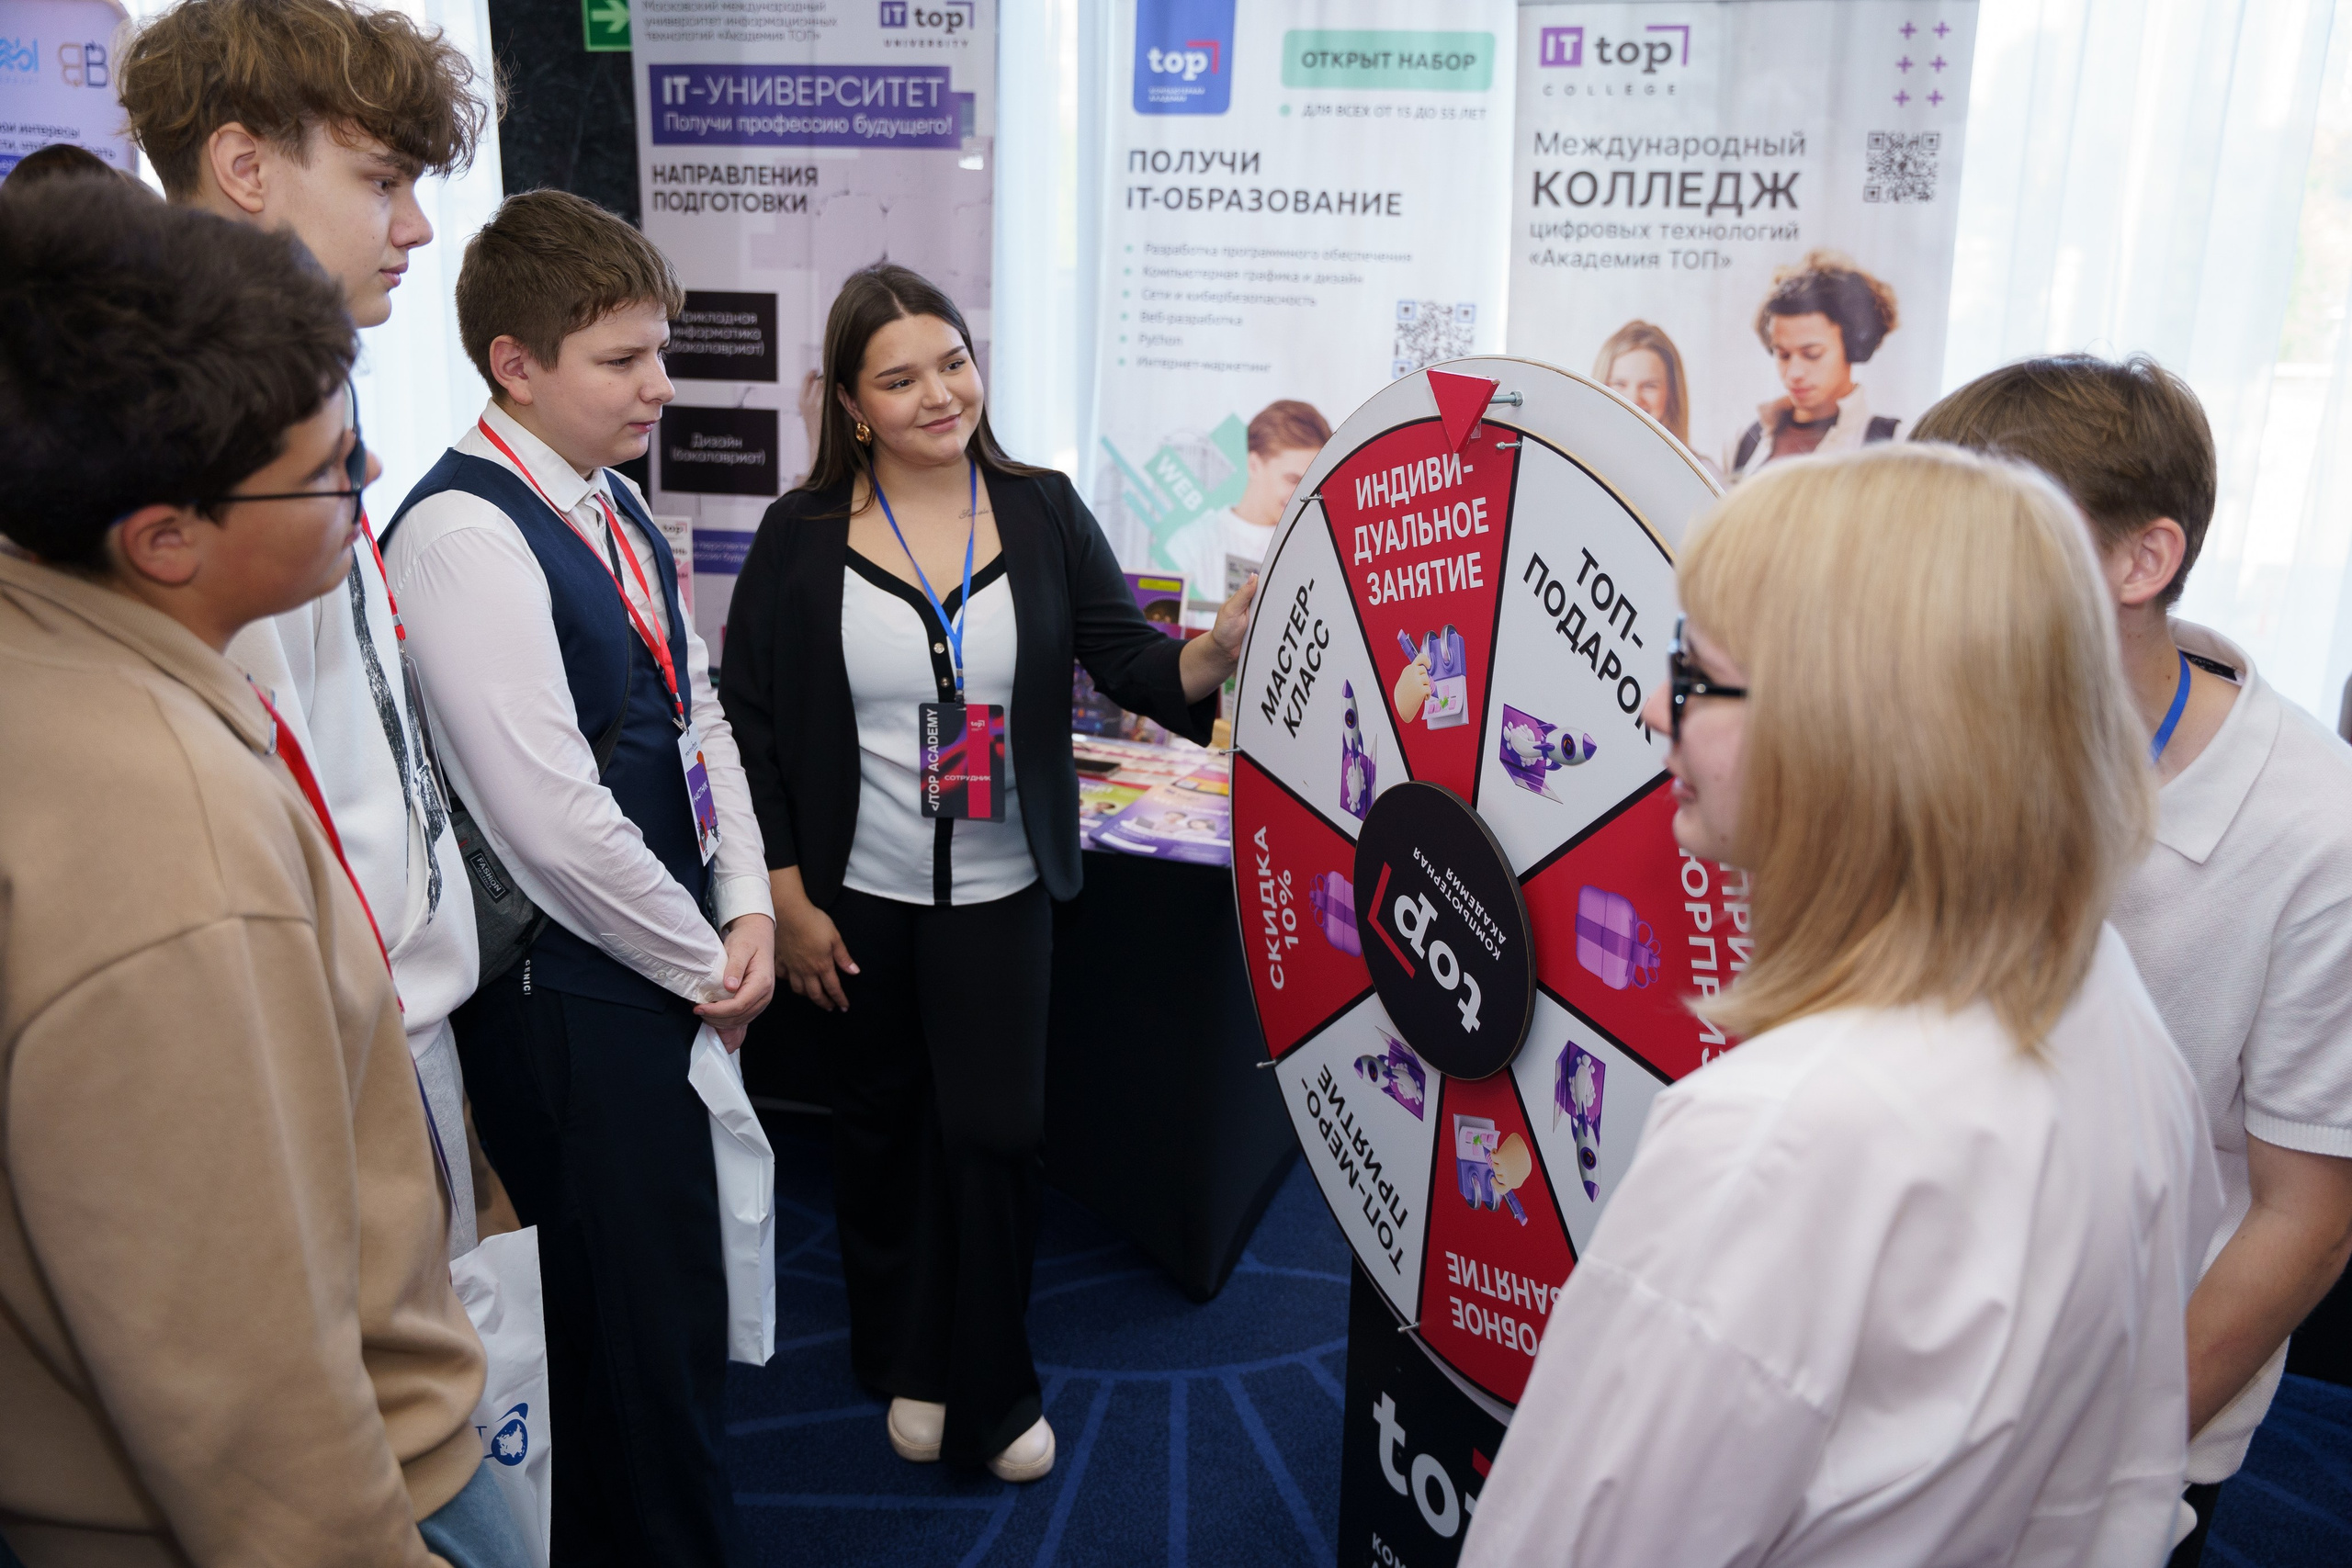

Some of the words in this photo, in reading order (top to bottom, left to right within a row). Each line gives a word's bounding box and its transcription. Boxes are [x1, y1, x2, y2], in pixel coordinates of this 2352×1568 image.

[883, 6, 904, 25] IT
[914, 8, 965, 33] top
[1147, 46, 1209, 81] top
[1301, 51, 1393, 71] ОТКРЫТ
[1397, 51, 1477, 72] НАБОР
[1545, 33, 1578, 62] IT
[1595, 34, 1672, 74] top
[661, 74, 945, 108] IT-УНИВЕРСИТЕТ
[1542, 84, 1677, 96] COLLEGE
[663, 111, 733, 137] Получи
[737, 114, 850, 136] профессию
[853, 114, 954, 139] будущего!
[1532, 130, 1807, 163] Международный
[651, 164, 819, 186] НАПРАВЛЕНИЯ
[1128, 150, 1261, 175] ПОЛУЧИ
[651, 191, 808, 215] ПОДГОТОВКИ
[1125, 186, 1404, 218] IT-ОБРАЗОВАНИЕ
[1531, 169, 1802, 219] КОЛЛЕДЖ
[1529, 219, 1651, 243] цифровых
[1659, 220, 1800, 243] технологий
[1528, 248, 1661, 270] «Академия
[1669, 250, 1733, 270] ТОП»
[1157, 454, 1204, 514] WEB
[1354, 452, 1475, 511] ИНДИВИ-
[1353, 496, 1489, 566] ДУАЛЬНОЕ
[1366, 551, 1485, 606] ЗАНЯТИЕ
[1575, 547, 1645, 650] ТОП-
[1260, 578, 1317, 726] МАСТЕР-
[1283, 617, 1331, 739] КЛАСС
[926, 708, 939, 773] ACADEMY
[944, 774, 992, 783] СОТРУДНИК
[476, 857, 502, 892] FASHION
[1252, 825, 1285, 990] СКИДКА
[1281, 868, 1301, 951] 10%
[1412, 846, 1501, 962] КОМПЬЮТЕРНАЯ
[1445, 867, 1507, 945] АКАДЕМИЯ
[1719, 860, 1756, 992] ПРИ
[1393, 891, 1483, 1034] top
[1316, 1063, 1409, 1232] ПРИЯТИЕ
[1449, 1294, 1539, 1358] ОБНОЕ
[1372, 1390, 1477, 1540] to
